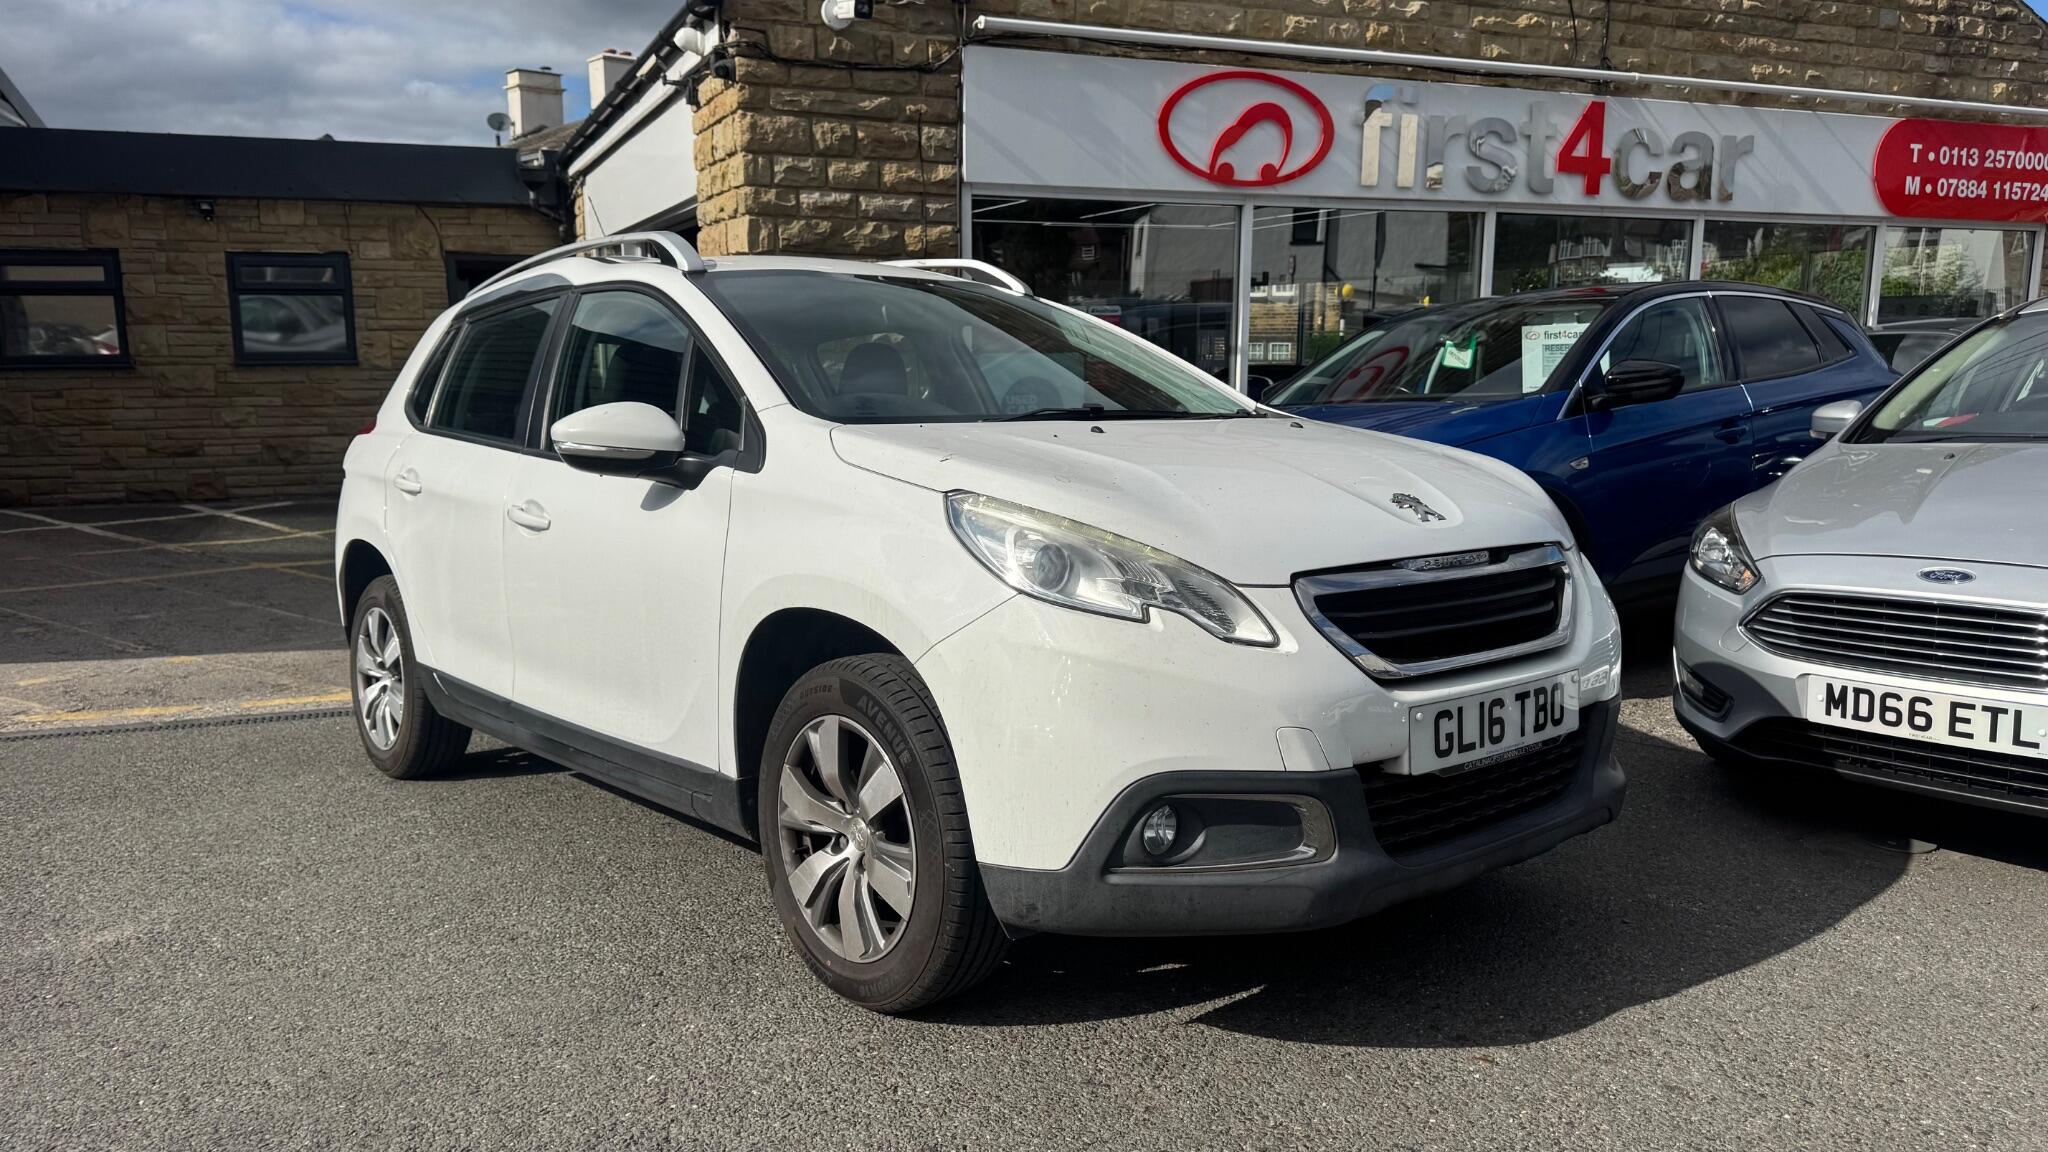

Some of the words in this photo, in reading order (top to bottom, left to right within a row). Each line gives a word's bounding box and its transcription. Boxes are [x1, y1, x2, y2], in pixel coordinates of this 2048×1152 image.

[1359, 84, 1755, 202] first4car
[1910, 143, 1923, 163] T
[1939, 145, 1979, 167] 0113
[1905, 176, 1921, 196] M
[1937, 178, 1987, 199] 07884
[1993, 181, 2048, 202] 115724
[1006, 394, 1037, 404] USED
[856, 695, 912, 766] AVENUE
[1434, 697, 1506, 759] GL16
[1515, 681, 1565, 738] TBO
[1825, 682, 1933, 733] MD66
[1948, 700, 2041, 750] ETL
